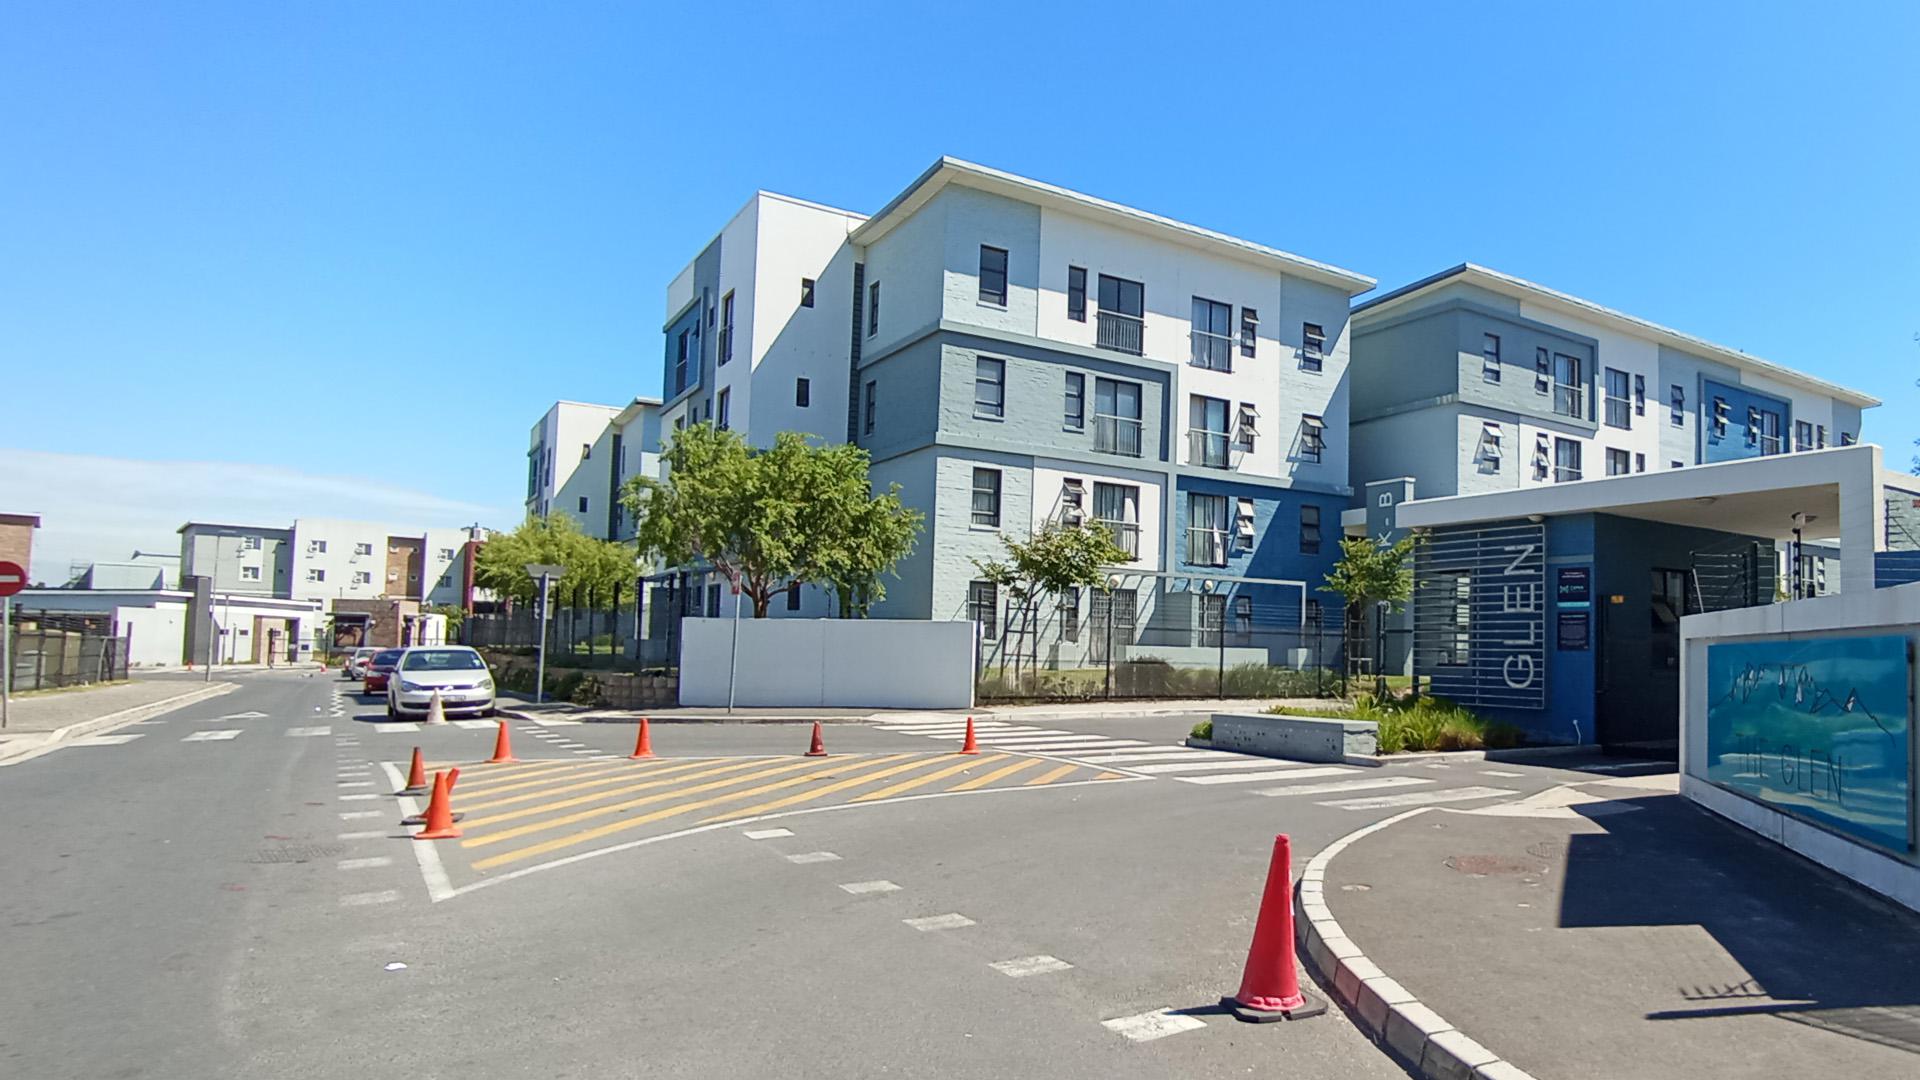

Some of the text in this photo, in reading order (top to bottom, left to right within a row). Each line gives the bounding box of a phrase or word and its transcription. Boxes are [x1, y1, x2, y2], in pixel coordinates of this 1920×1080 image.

[1503, 544, 1535, 689] GLEN
[1735, 732, 1842, 805] THE GLEN
